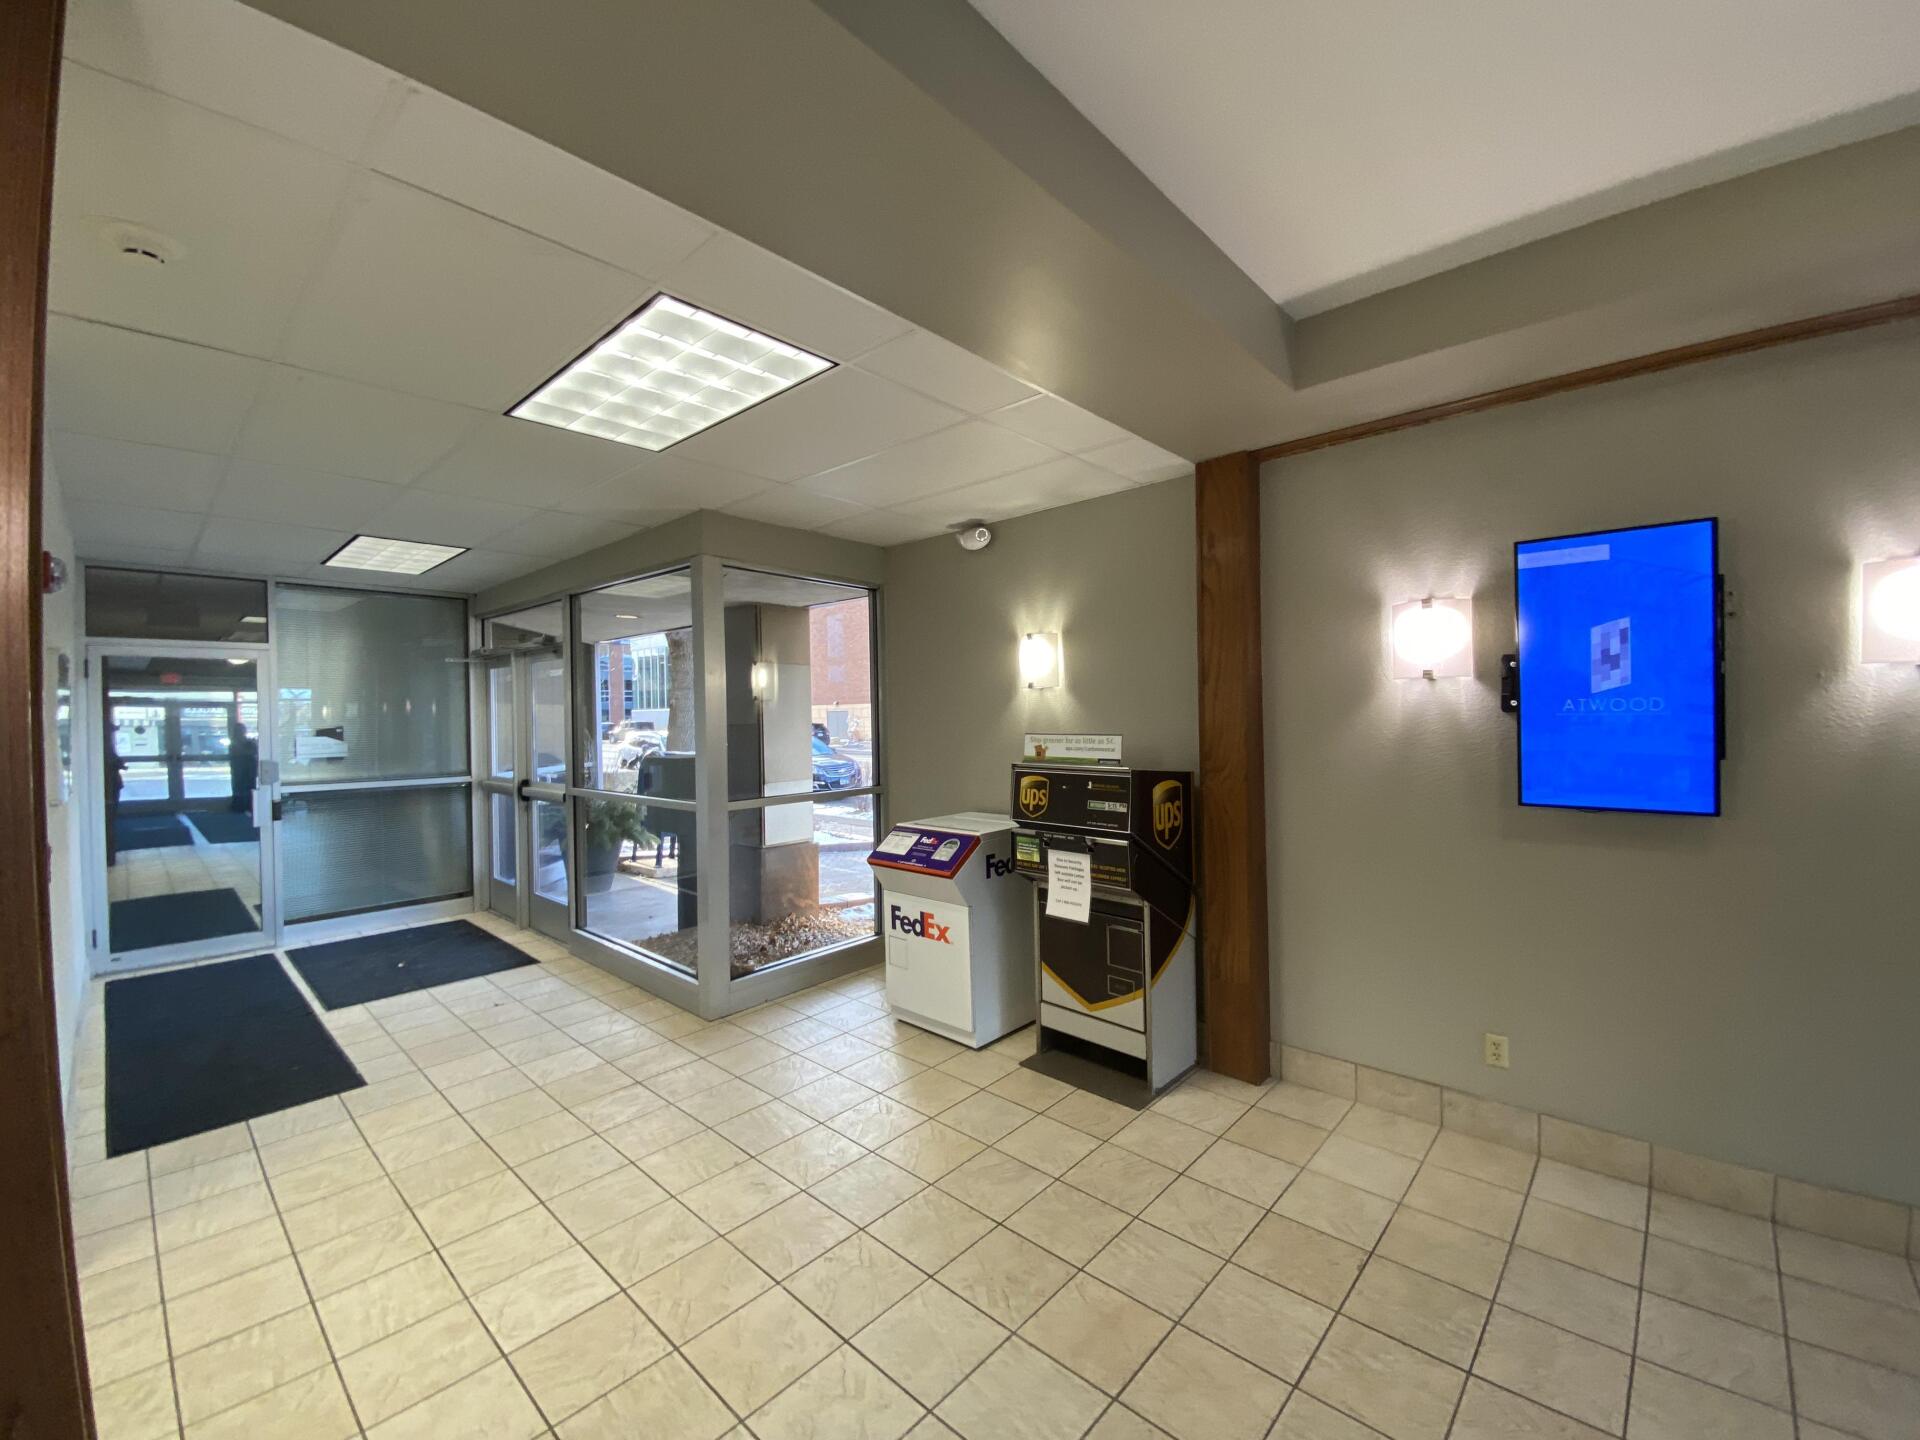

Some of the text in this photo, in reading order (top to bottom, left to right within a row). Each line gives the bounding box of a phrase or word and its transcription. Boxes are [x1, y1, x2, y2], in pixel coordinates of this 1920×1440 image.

[1562, 697, 1664, 713] ATWOOD
[1022, 788, 1047, 811] ups
[1155, 800, 1181, 840] ups
[920, 836, 938, 845] FedEx
[891, 904, 951, 945] FedEx
